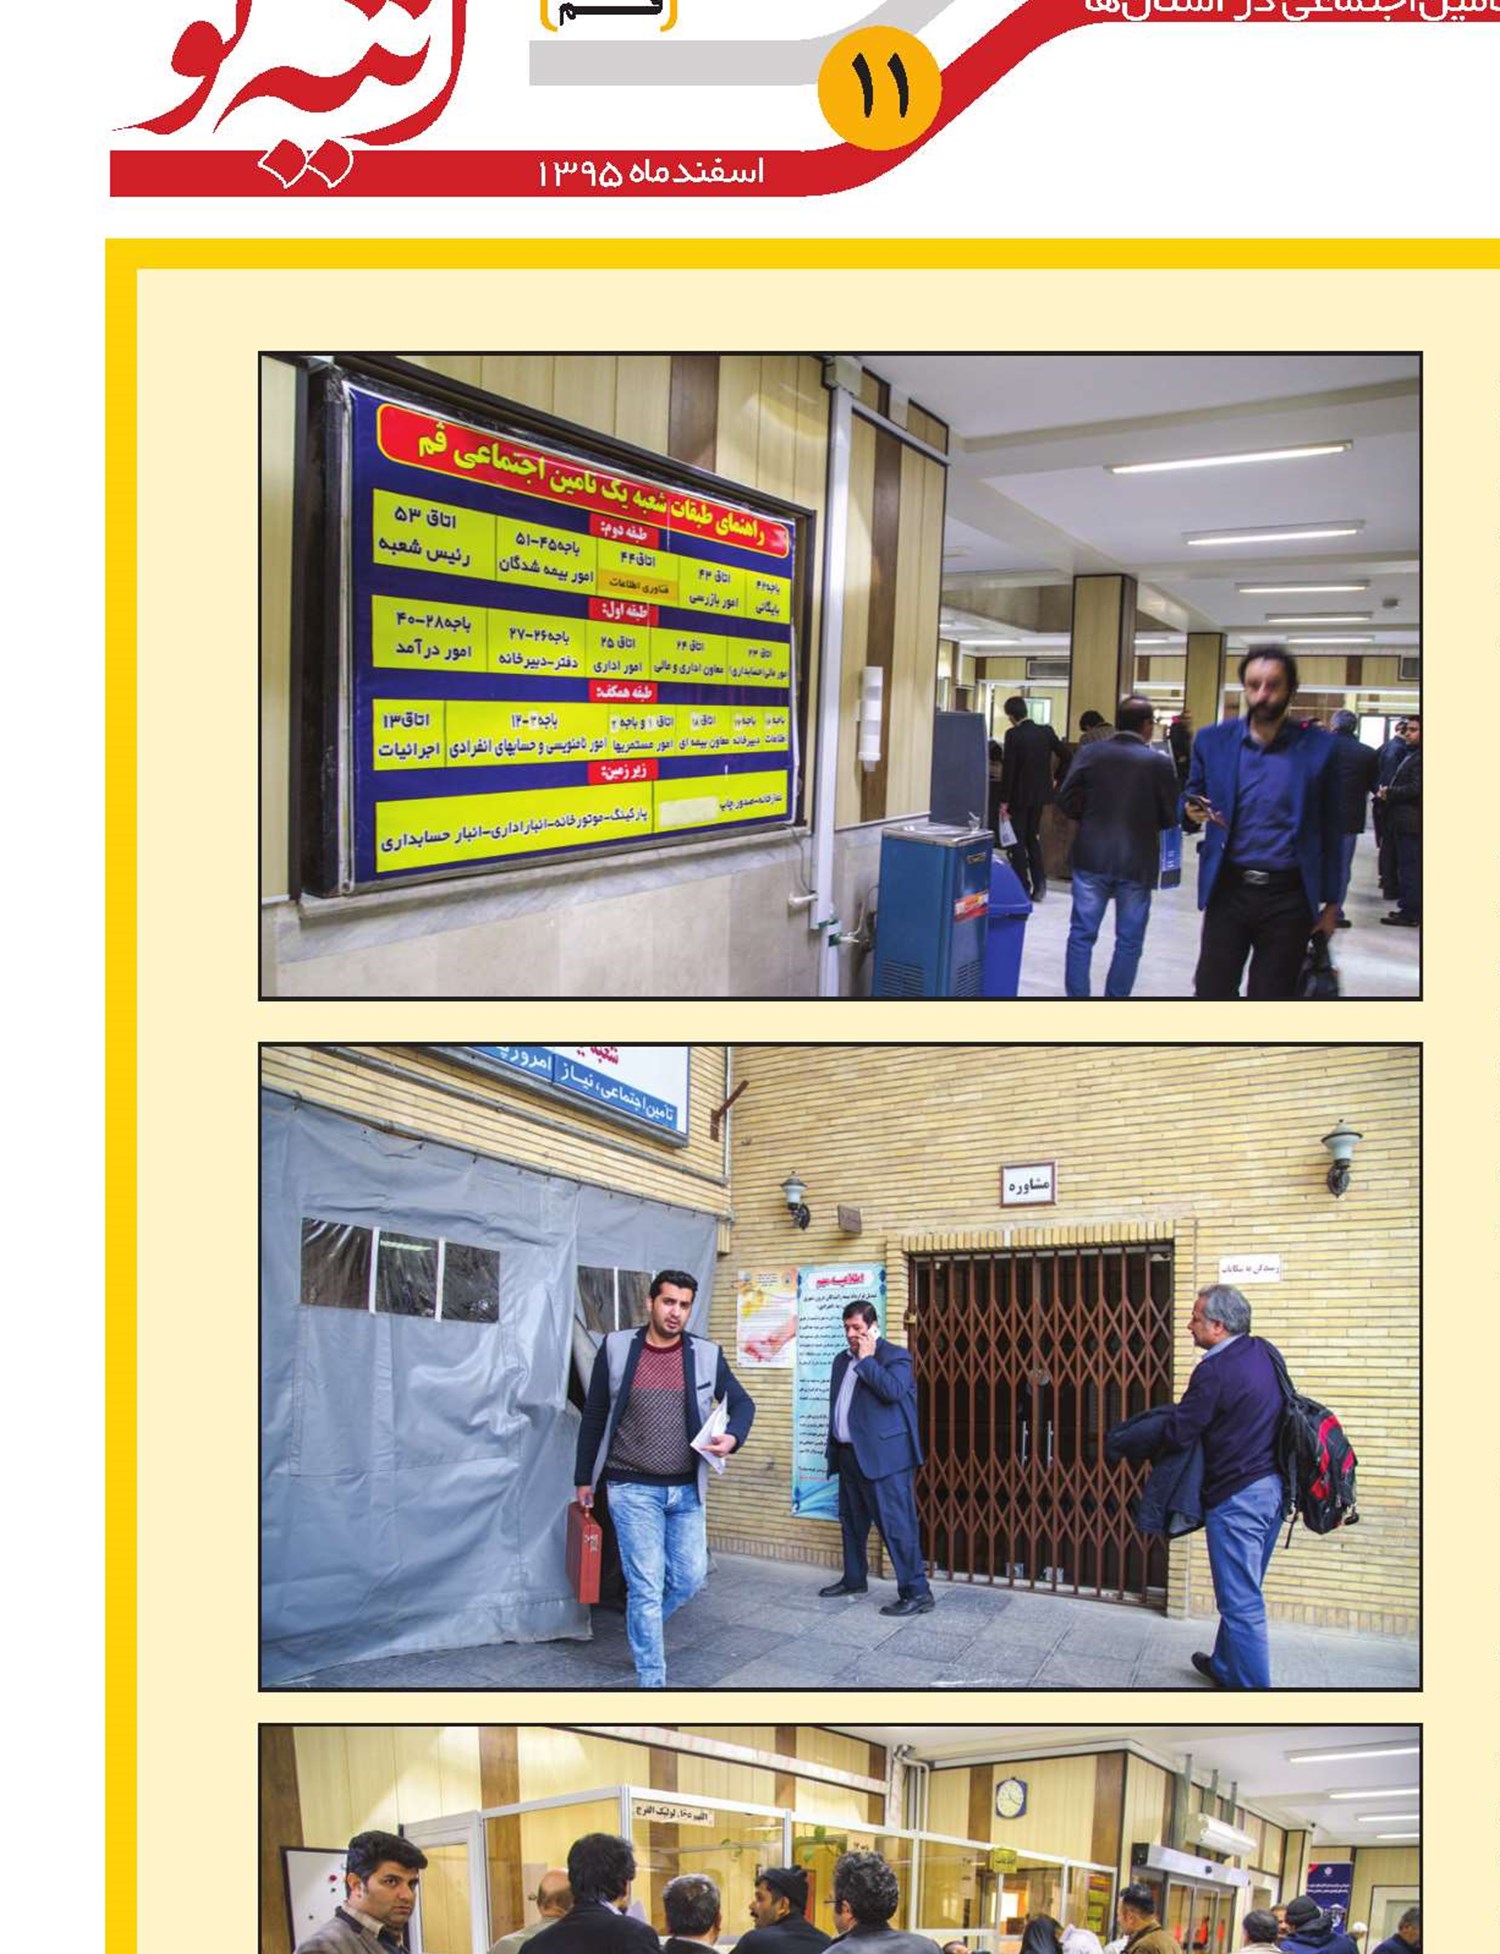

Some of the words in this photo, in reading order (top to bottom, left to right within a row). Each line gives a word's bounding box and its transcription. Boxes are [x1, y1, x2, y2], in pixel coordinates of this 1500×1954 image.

[852, 52, 909, 118] ۱۱
[538, 159, 624, 188] ۱۳۹۵
[418, 420, 447, 457] قم
[453, 443, 545, 484] اجتماعی
[601, 479, 628, 509] یک
[633, 490, 667, 515] شعبه
[394, 506, 422, 523] ۵۳
[426, 510, 457, 529] اتاق
[671, 498, 713, 528] طبقات
[626, 523, 648, 542] طبقه
[715, 519, 765, 546] راهنمای
[378, 537, 422, 556] شعبه
[426, 547, 470, 567] رئیس
[498, 555, 541, 575] شدگان
[543, 564, 569, 582] بیمه
[571, 571, 594, 585] امور
[714, 569, 731, 584] اتاق
[608, 577, 641, 590] اطلاعات
[642, 584, 670, 595] فناوری
[689, 593, 720, 607] بازرسی
[721, 598, 739, 610] امور
[625, 603, 649, 621] طبقه
[617, 635, 636, 649] اتاق
[689, 639, 704, 652] اتاق
[444, 646, 472, 661] امور
[593, 660, 621, 673] اداری
[623, 661, 643, 675] امور
[631, 684, 653, 703] طبقه
[656, 715, 674, 727] اتاق
[377, 742, 441, 761] اجرائیات
[449, 739, 493, 758] انفرادی
[537, 744, 543, 755] و
[589, 738, 607, 753] امور
[655, 740, 674, 752] امور
[630, 761, 648, 778] زیر
[380, 830, 451, 852] حسابداری
[561, 1061, 594, 1090] نیاز
[1008, 1177, 1050, 1196] مشاوره
